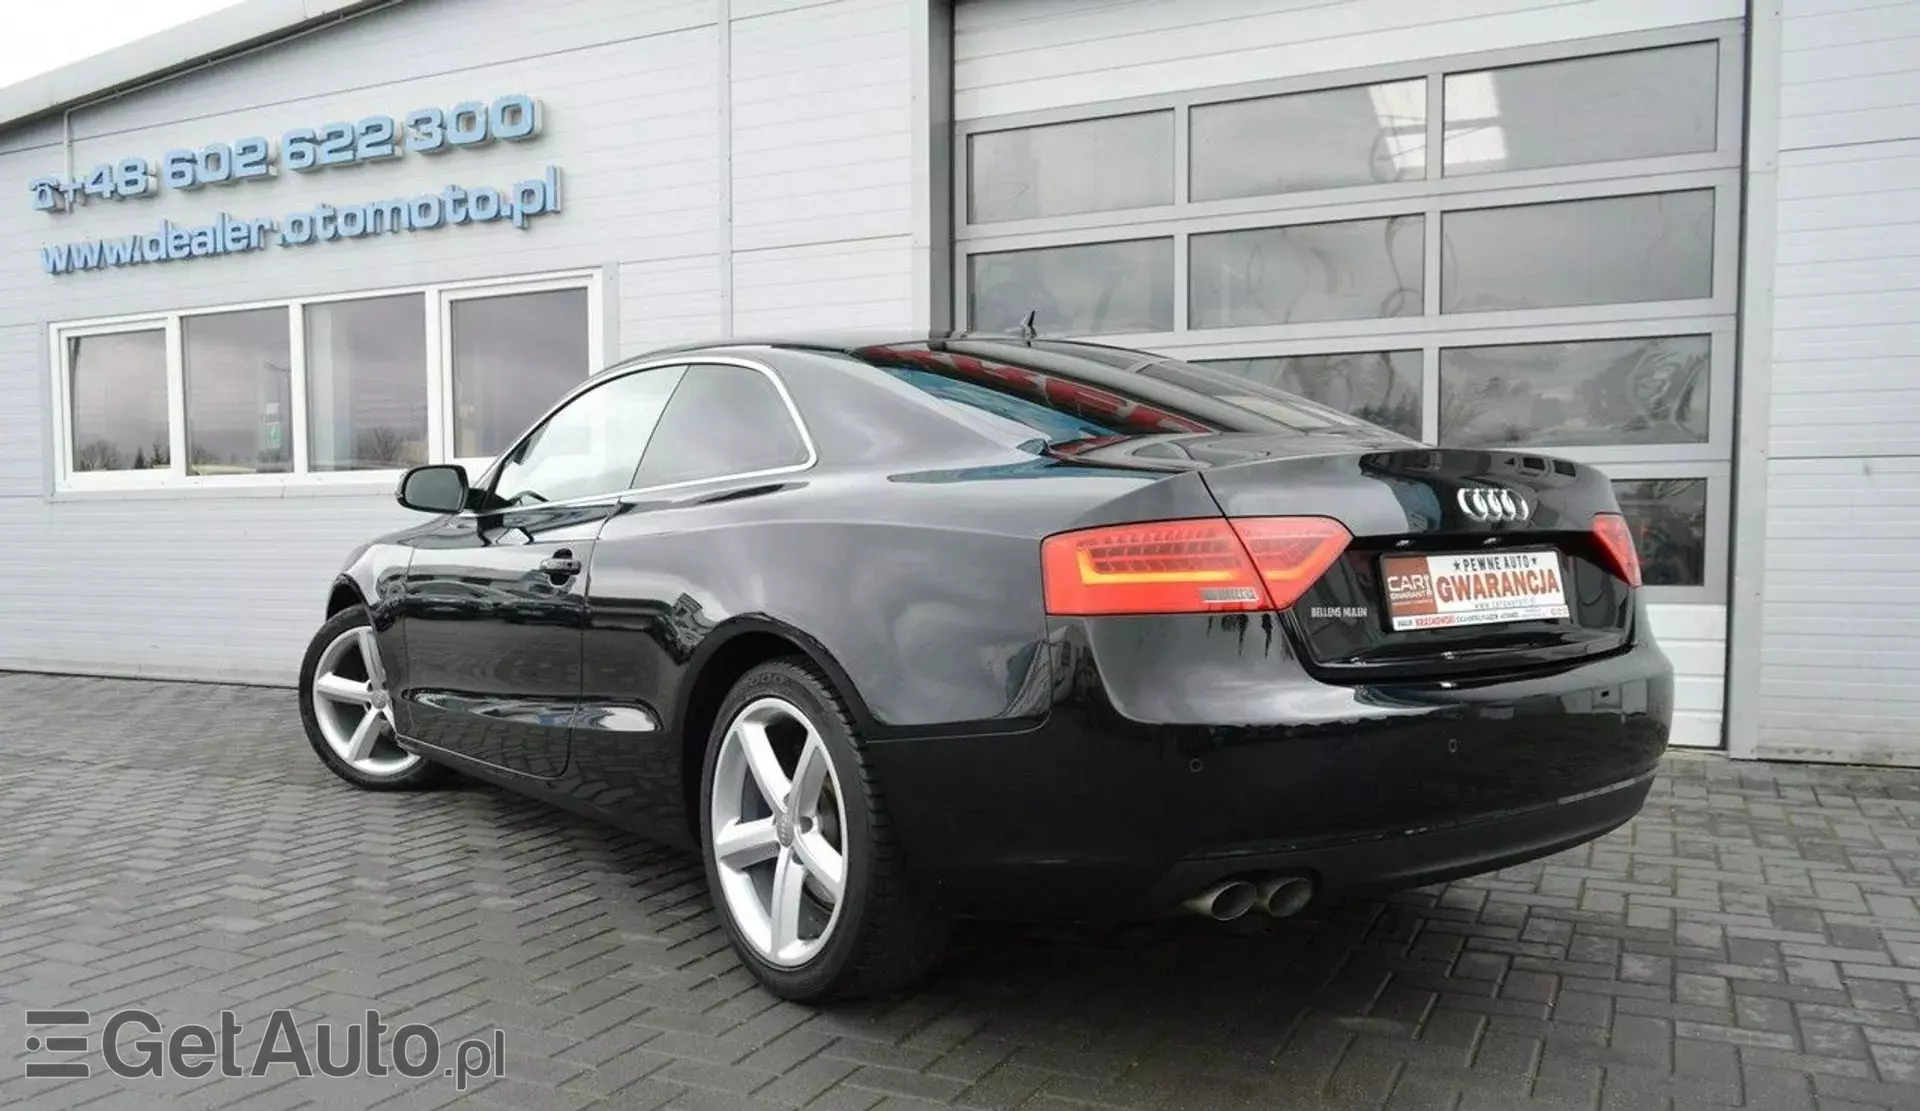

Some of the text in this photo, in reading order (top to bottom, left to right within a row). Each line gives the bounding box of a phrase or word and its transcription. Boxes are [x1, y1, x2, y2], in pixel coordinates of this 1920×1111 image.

[163, 137, 272, 190] 602
[281, 114, 398, 171] 622
[405, 95, 540, 154] 300
[41, 164, 561, 275] www.dealer.otomoto.pl
[1435, 568, 1560, 604] GWARANCJA
[1463, 554, 1531, 572] PEWNE AUTO
